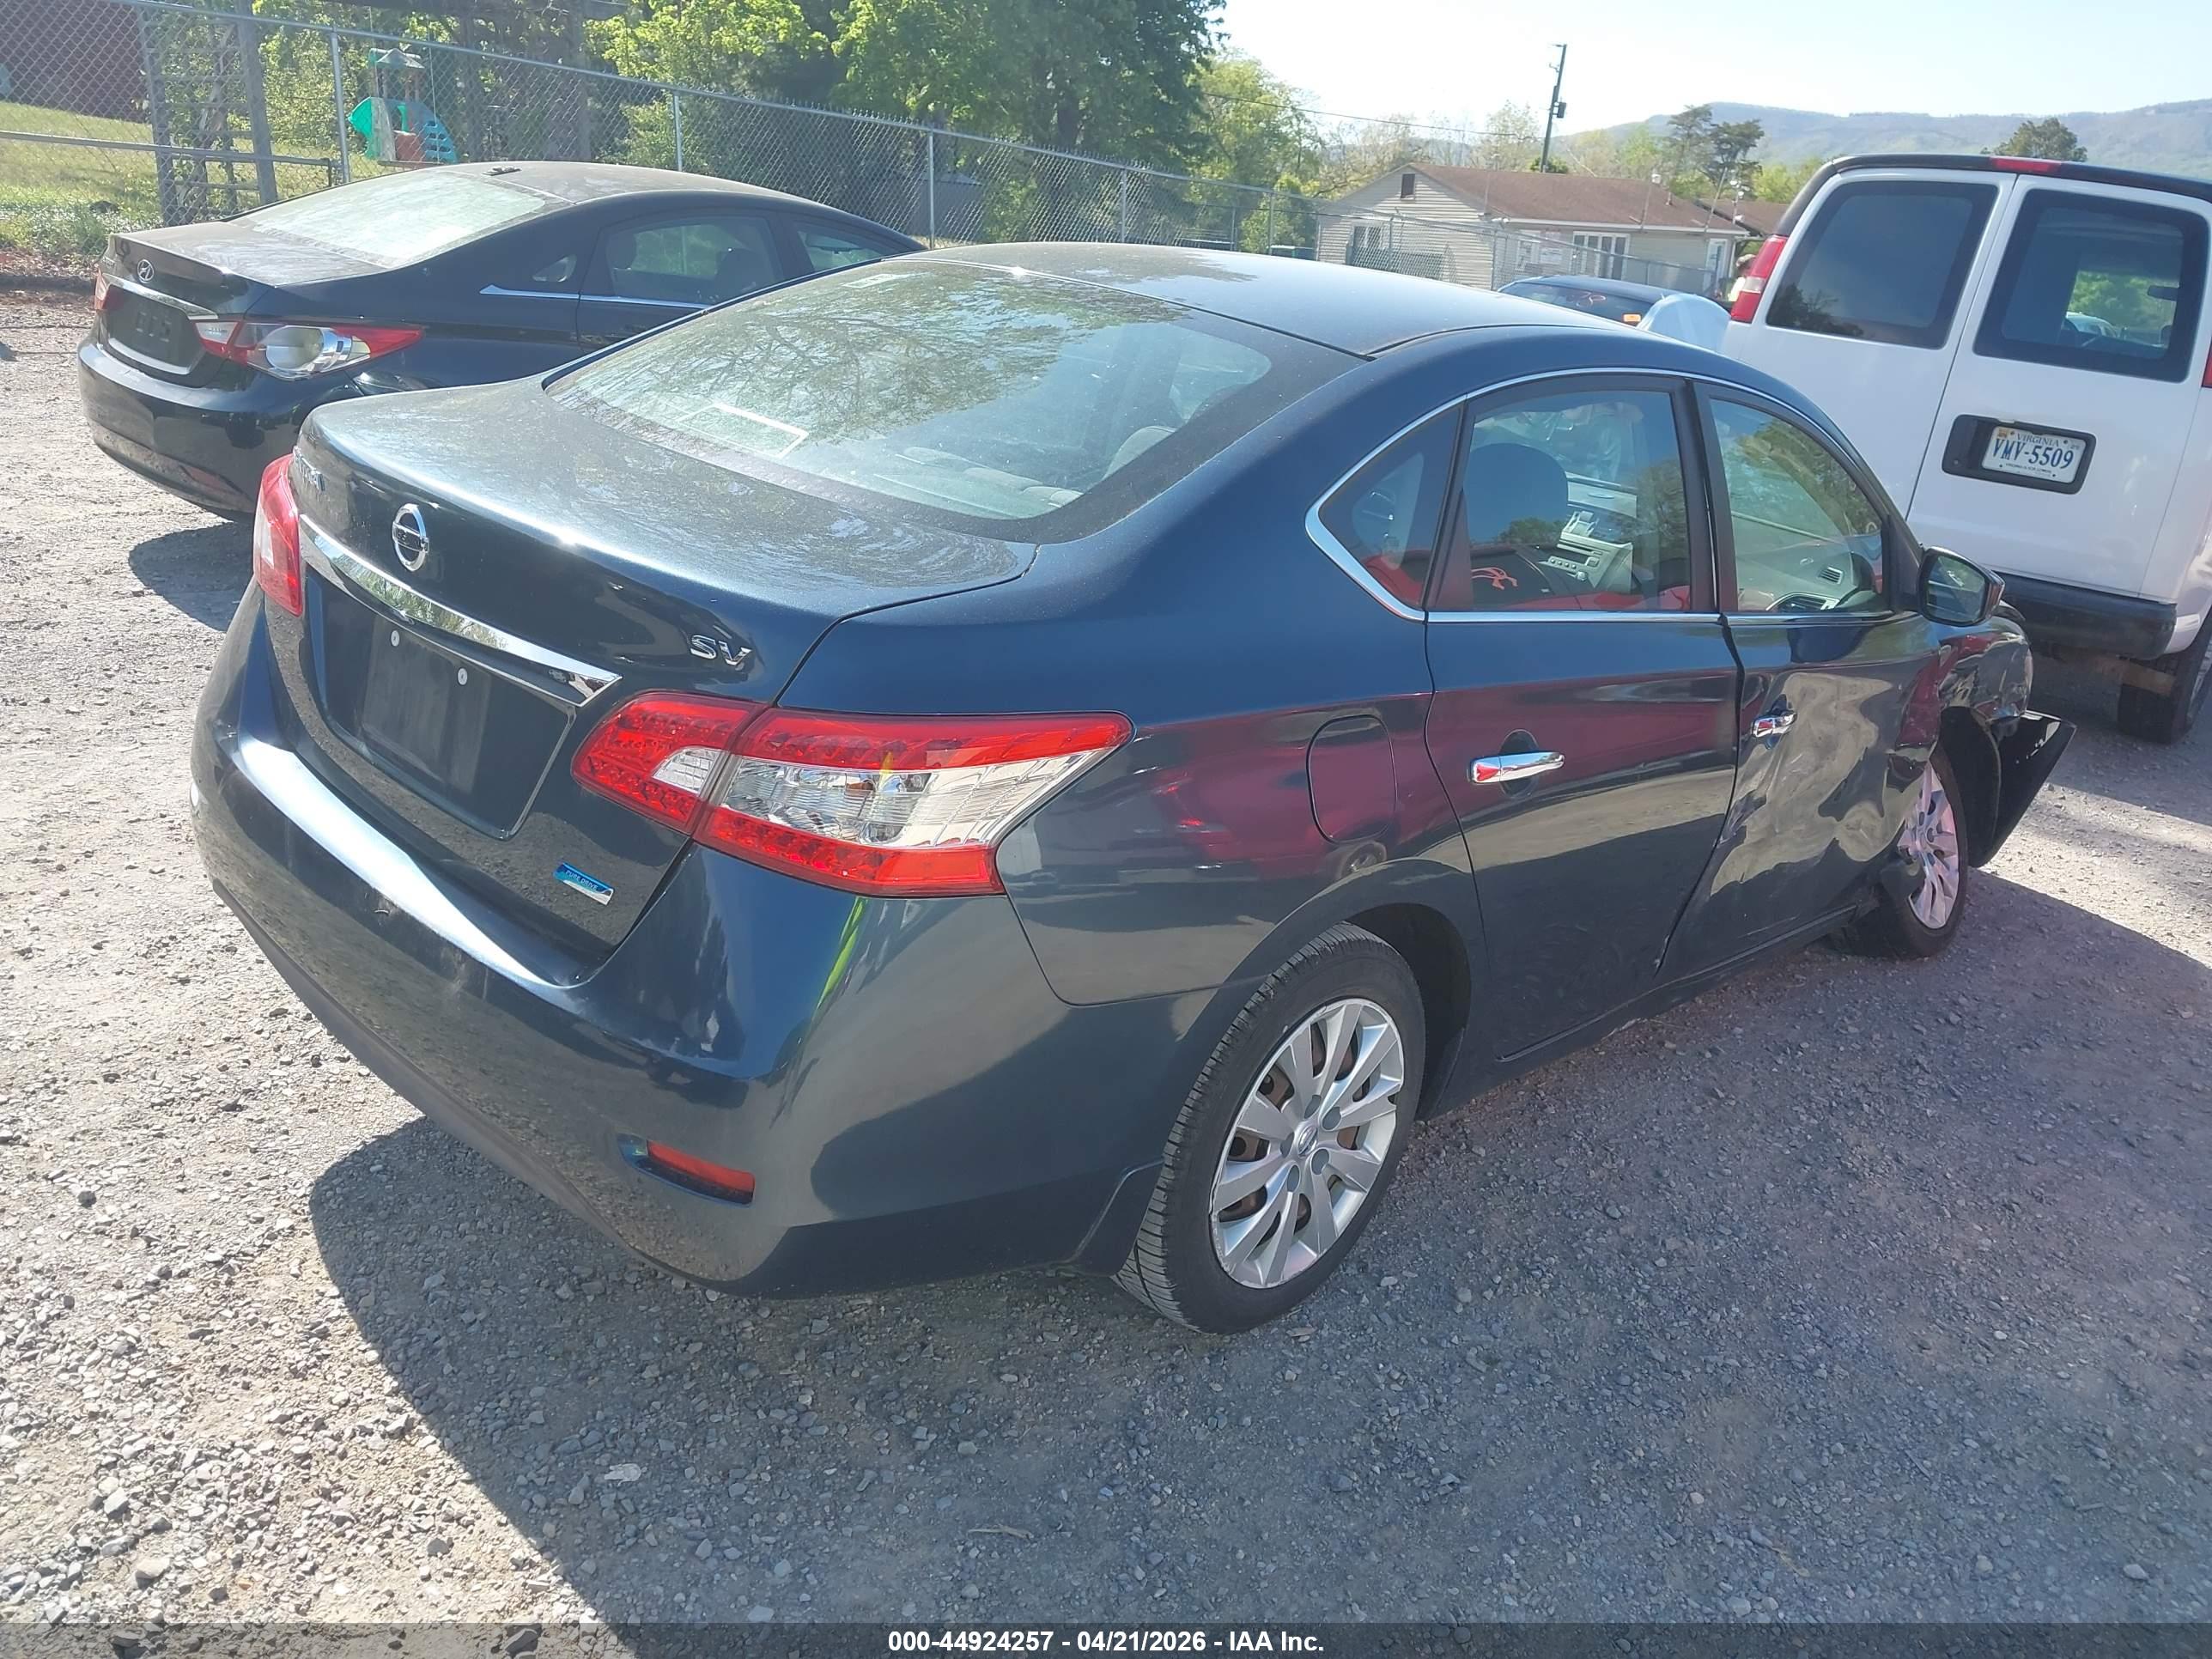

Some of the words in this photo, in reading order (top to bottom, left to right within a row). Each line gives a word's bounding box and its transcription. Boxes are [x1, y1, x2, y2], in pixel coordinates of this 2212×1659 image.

[2017, 433, 2061, 448] VIRGINIA
[690, 635, 752, 666] SV
[565, 870, 581, 881] PURE
[580, 878, 599, 891] DRIVE
